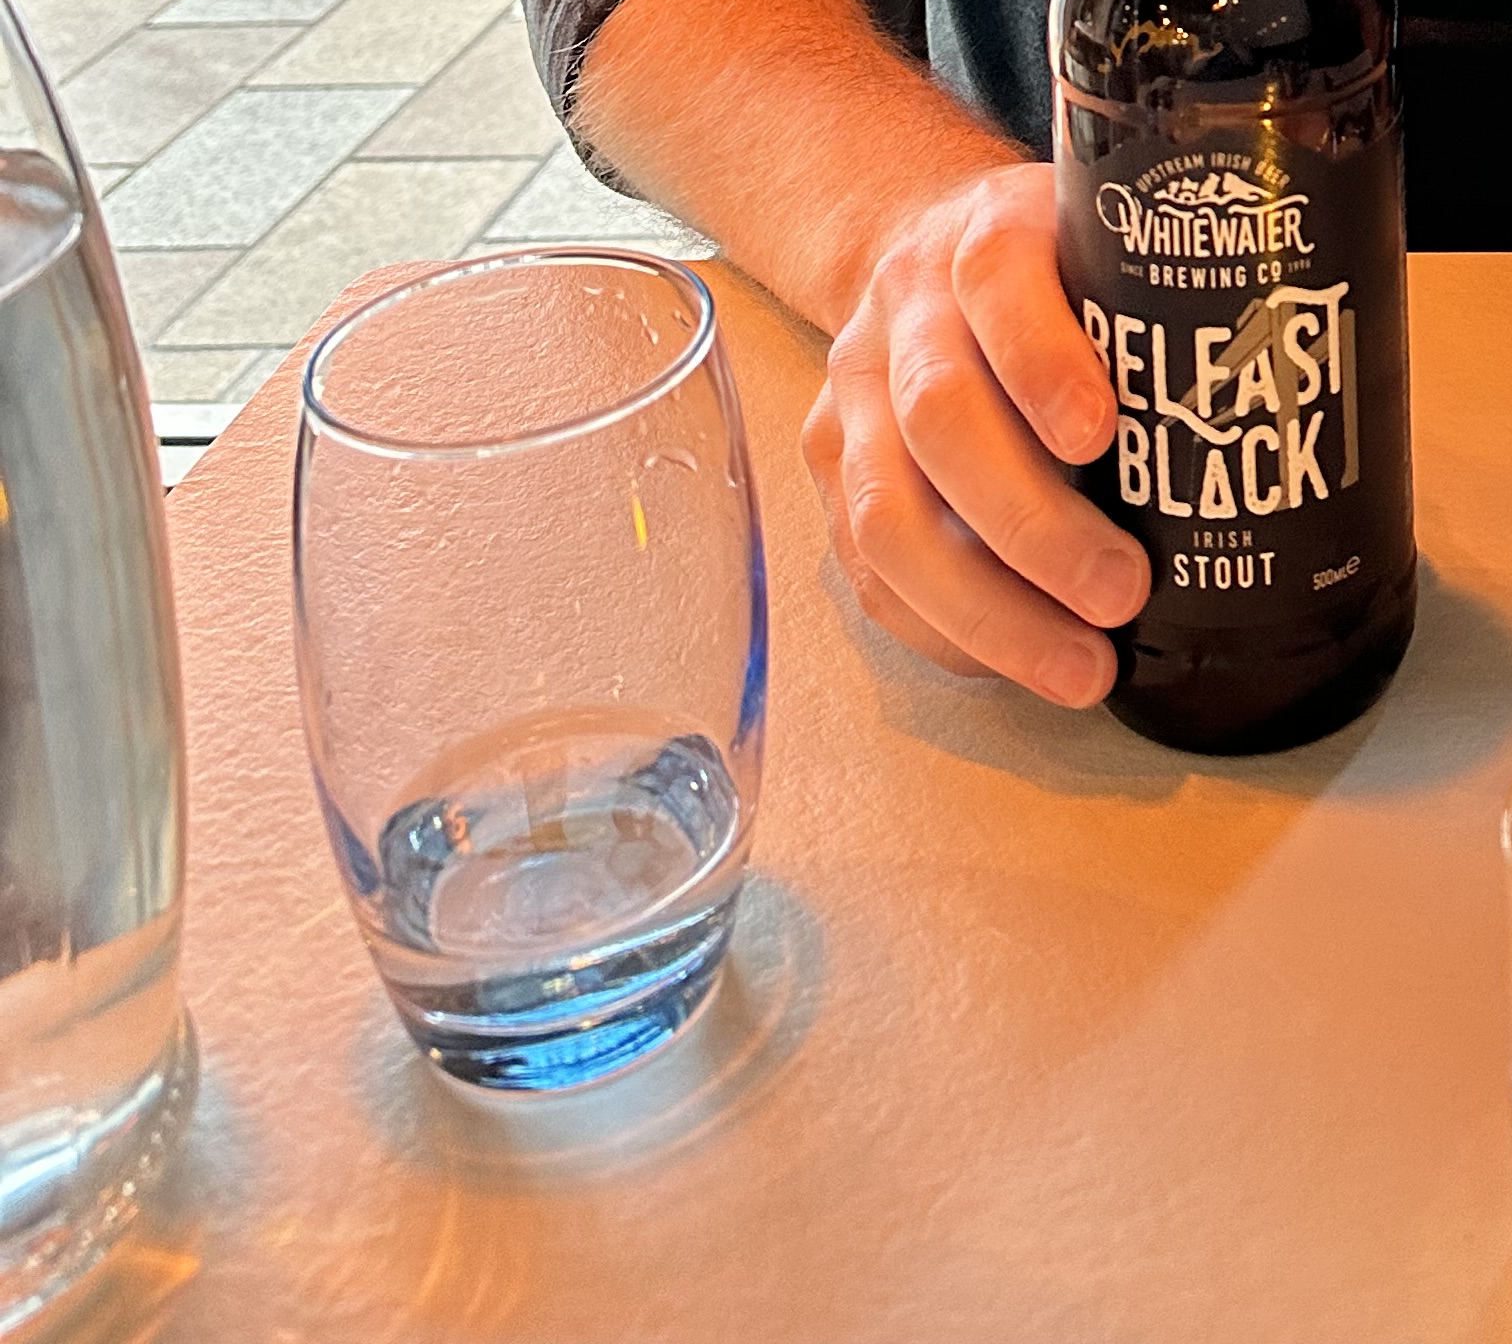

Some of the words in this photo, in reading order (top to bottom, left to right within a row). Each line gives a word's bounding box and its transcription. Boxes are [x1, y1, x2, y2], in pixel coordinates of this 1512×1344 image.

[1135, 153, 1205, 194] UPSTREAM
[1210, 152, 1252, 172] IRISH
[1096, 181, 1315, 257] WHITEWATER
[1149, 263, 1247, 289] BREWING
[1083, 281, 1350, 446] BELFAST
[1117, 410, 1330, 520] BLACK
[1193, 529, 1253, 549] IRISH
[1173, 552, 1275, 591] STOUT
